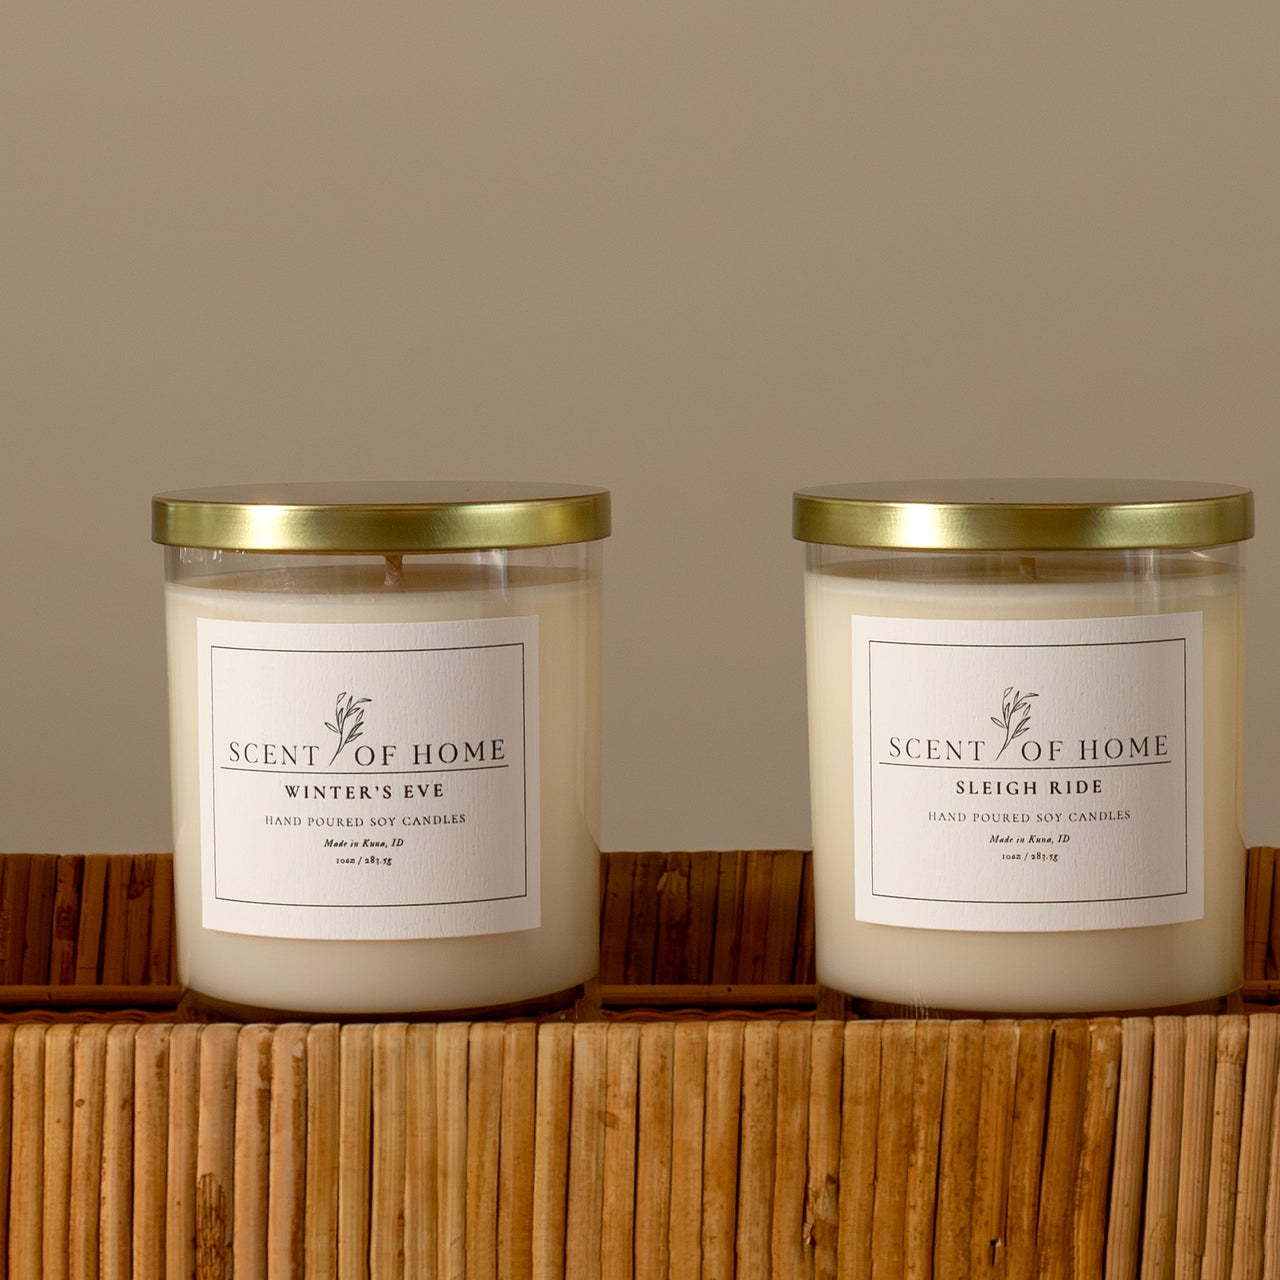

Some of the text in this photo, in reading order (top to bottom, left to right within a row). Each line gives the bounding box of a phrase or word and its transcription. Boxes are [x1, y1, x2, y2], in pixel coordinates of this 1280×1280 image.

[229, 739, 505, 767] SCENT OF HOME
[889, 735, 1168, 762] SCENT OF HOME
[284, 783, 444, 800] WINTER'S EVE
[956, 779, 1102, 796] SLEIGH RIDE
[265, 813, 466, 828] HAND POURED SOY CANDLES
[928, 809, 1131, 823] HAND POURED SOY CANDLES
[323, 838, 404, 849] Made in Kuna, ID
[989, 834, 1071, 845] Made in Kuna, ID
